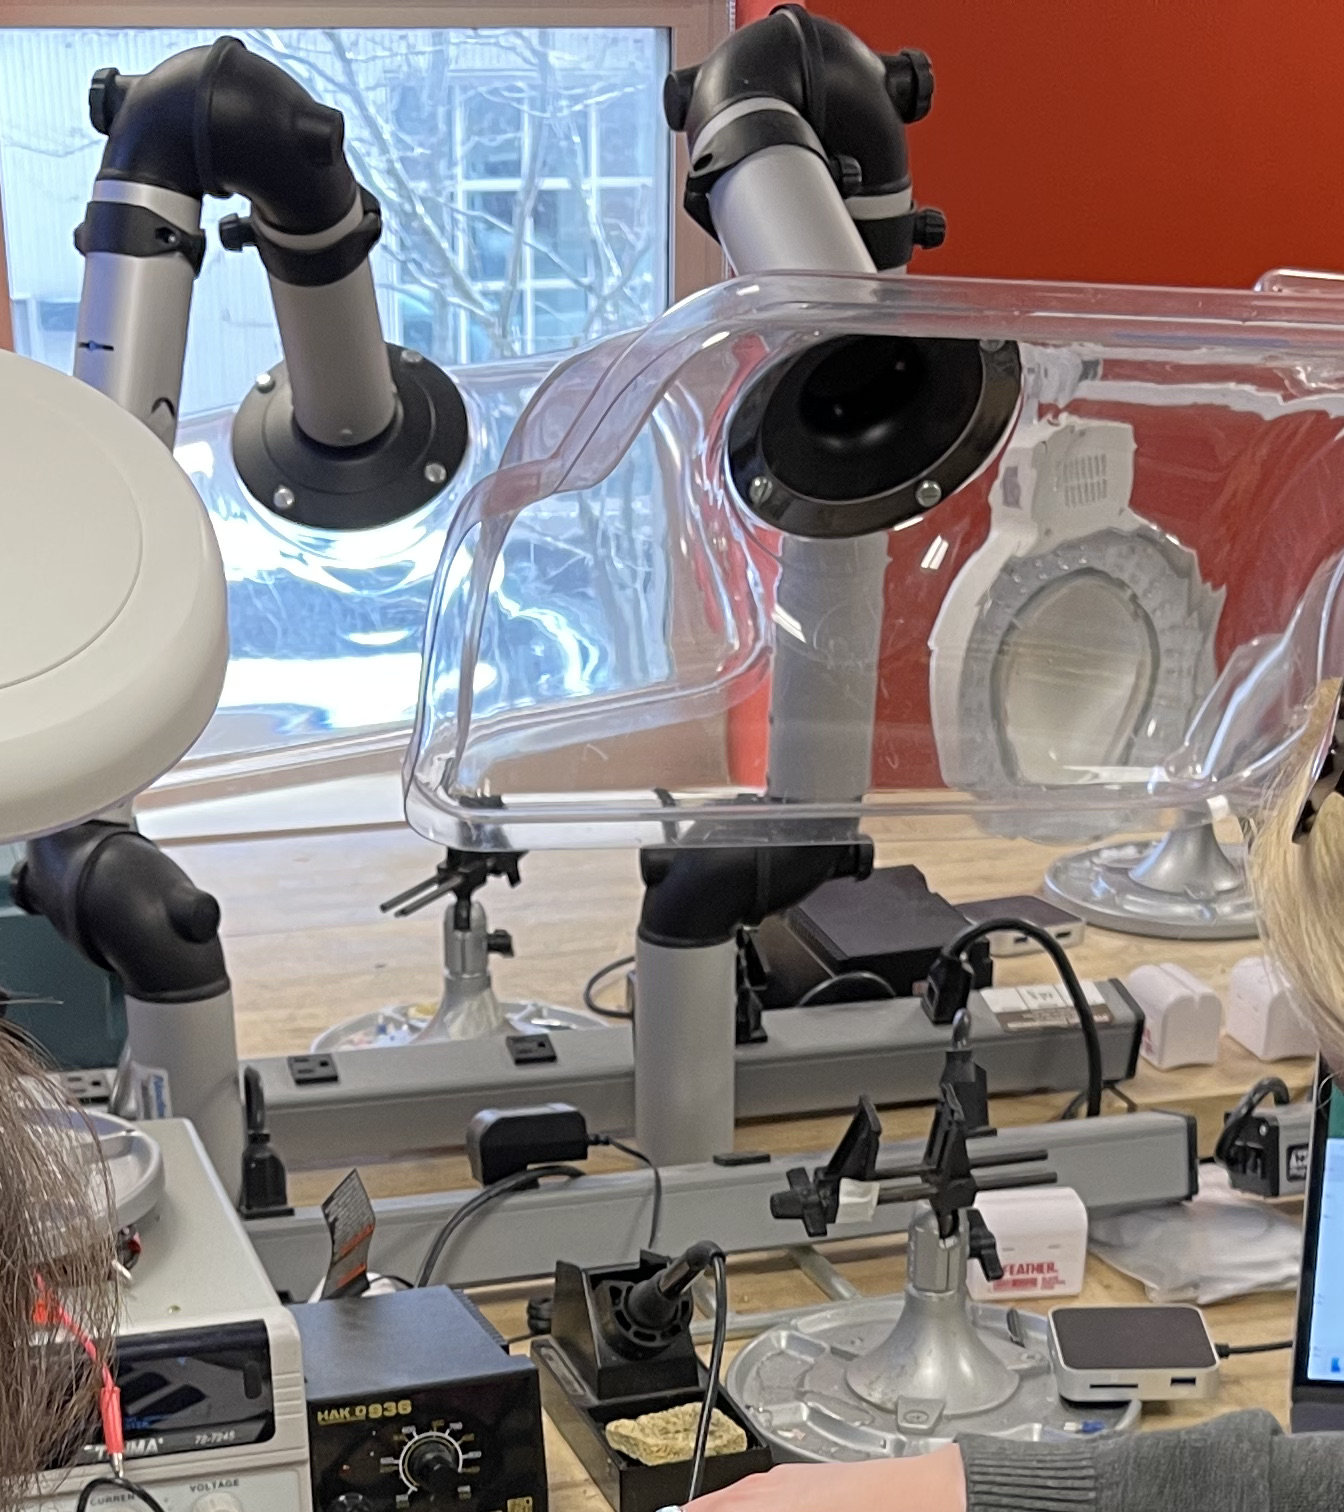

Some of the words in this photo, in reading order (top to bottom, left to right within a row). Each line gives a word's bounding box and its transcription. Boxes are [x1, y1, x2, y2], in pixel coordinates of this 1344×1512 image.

[317, 1405, 366, 1425] HAKO
[368, 1399, 412, 1419] 936
[189, 1478, 240, 1493] VOLTAGE
[90, 1493, 136, 1506] CURREN
